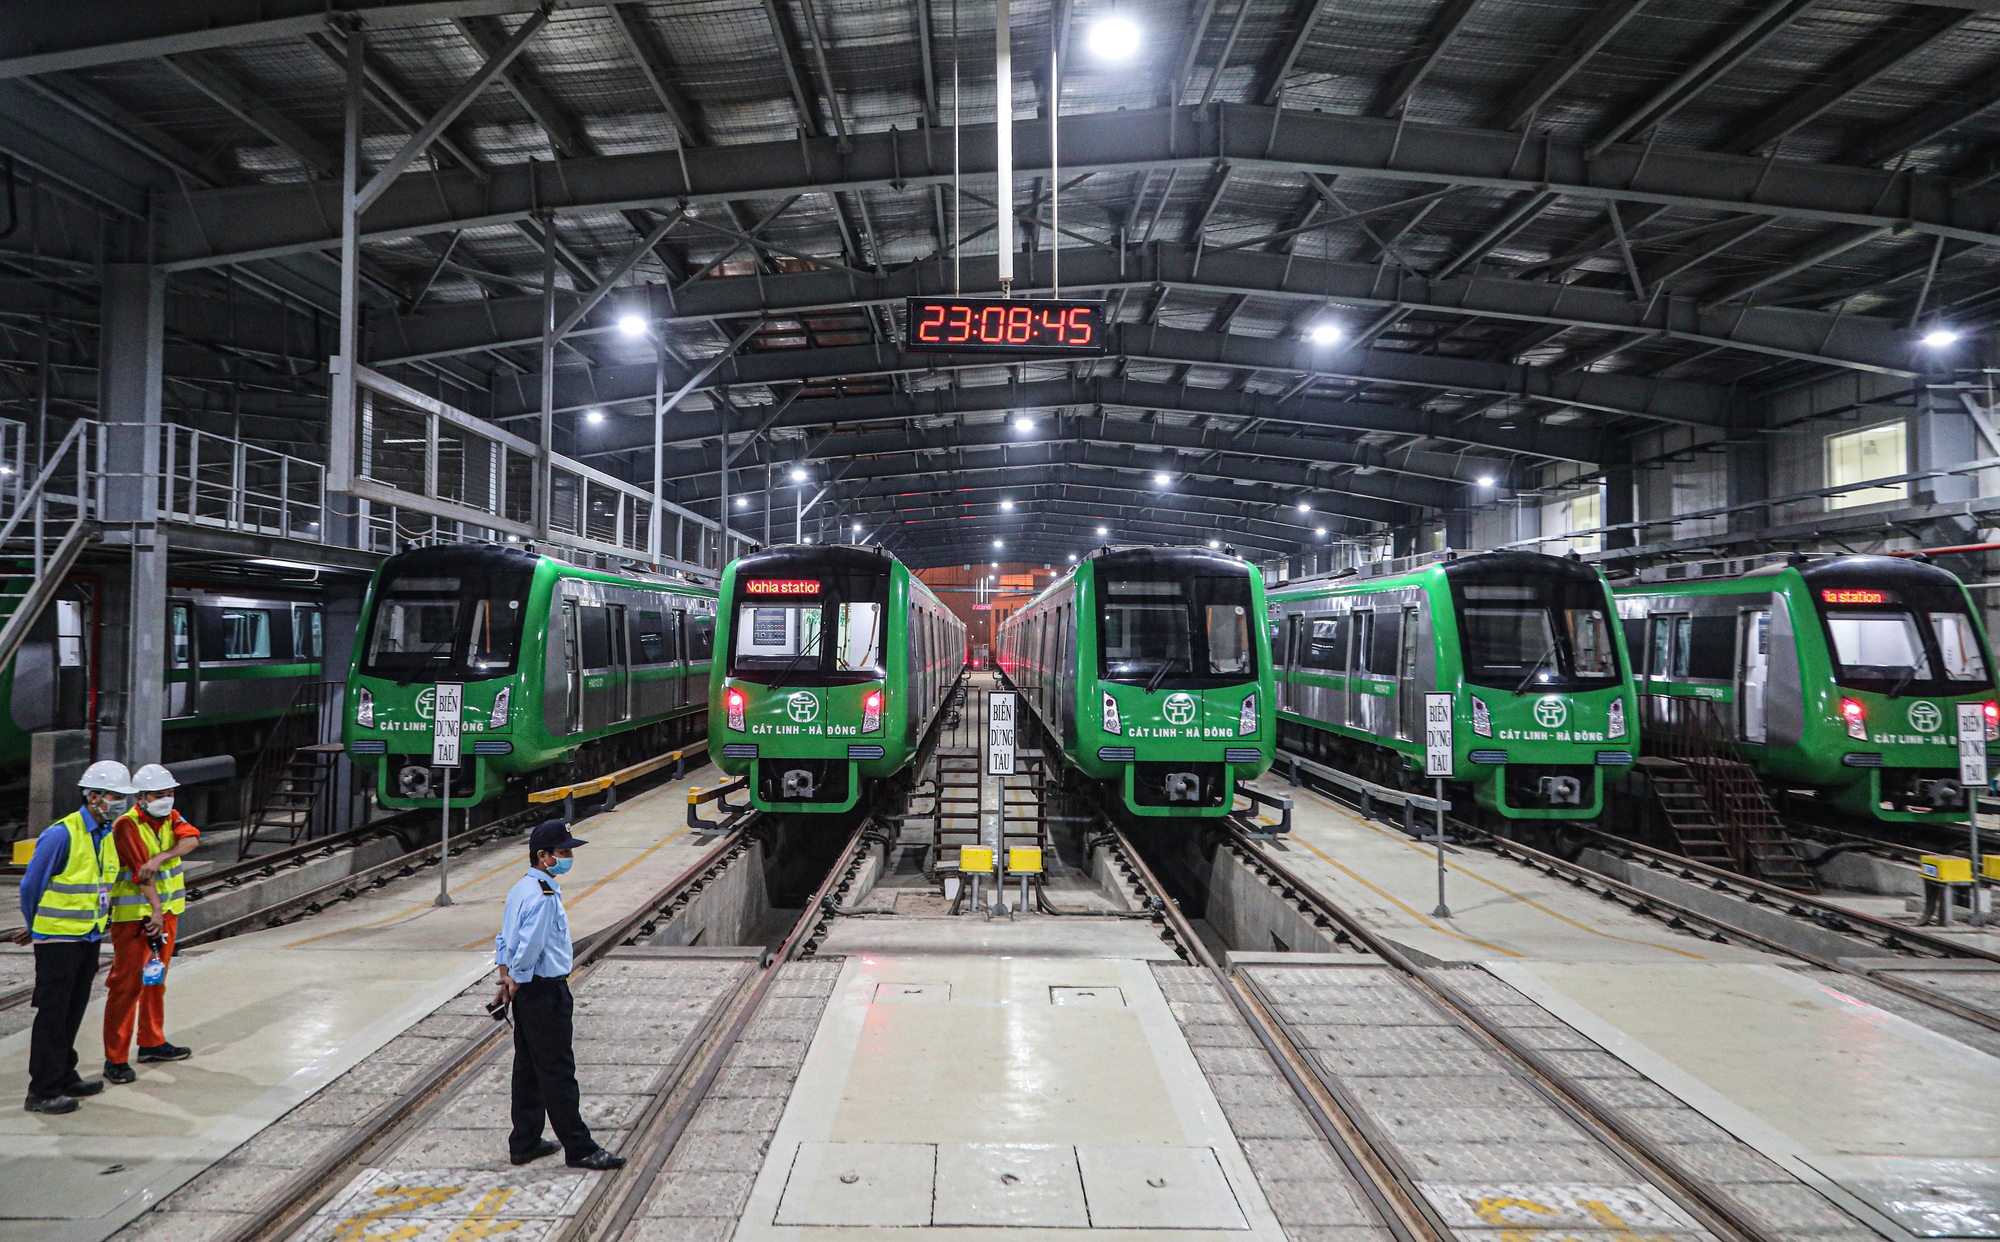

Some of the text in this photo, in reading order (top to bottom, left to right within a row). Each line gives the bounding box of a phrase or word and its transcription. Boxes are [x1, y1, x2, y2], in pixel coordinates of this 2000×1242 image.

[919, 305, 1092, 344] 23:08:45
[1839, 590, 1881, 603] station
[439, 688, 458, 713] BIỂN
[993, 697, 1012, 721] BIỂN
[1429, 698, 1448, 722] BIỂN
[380, 719, 400, 731] CÁT
[403, 721, 427, 731] LINH
[462, 720, 484, 732] ÔNG
[436, 716, 458, 737] DỪNG
[752, 723, 773, 734] CÁT
[776, 725, 799, 735] LINH
[809, 724, 822, 735] HÀ
[827, 724, 856, 735] ĐÔNG
[991, 725, 1013, 746] DỪNG
[1128, 726, 1149, 737] CÁT
[1153, 728, 1177, 737] LINH
[1186, 726, 1200, 737] HÀ
[1204, 726, 1233, 738] ĐÔNG
[1499, 728, 1521, 740] CÁT
[1523, 730, 1548, 741] LINH
[1556, 730, 1571, 741] HÀ
[1573, 730, 1603, 741] ĐÔNG
[1428, 726, 1451, 747] DỪNG
[1873, 732, 1896, 744] CÁT
[1898, 734, 1924, 745] LINH
[1931, 733, 1947, 746] HÀ
[438, 740, 455, 761] TÀU
[994, 749, 1010, 770] TÀU
[1431, 750, 1448, 771] TÀU
